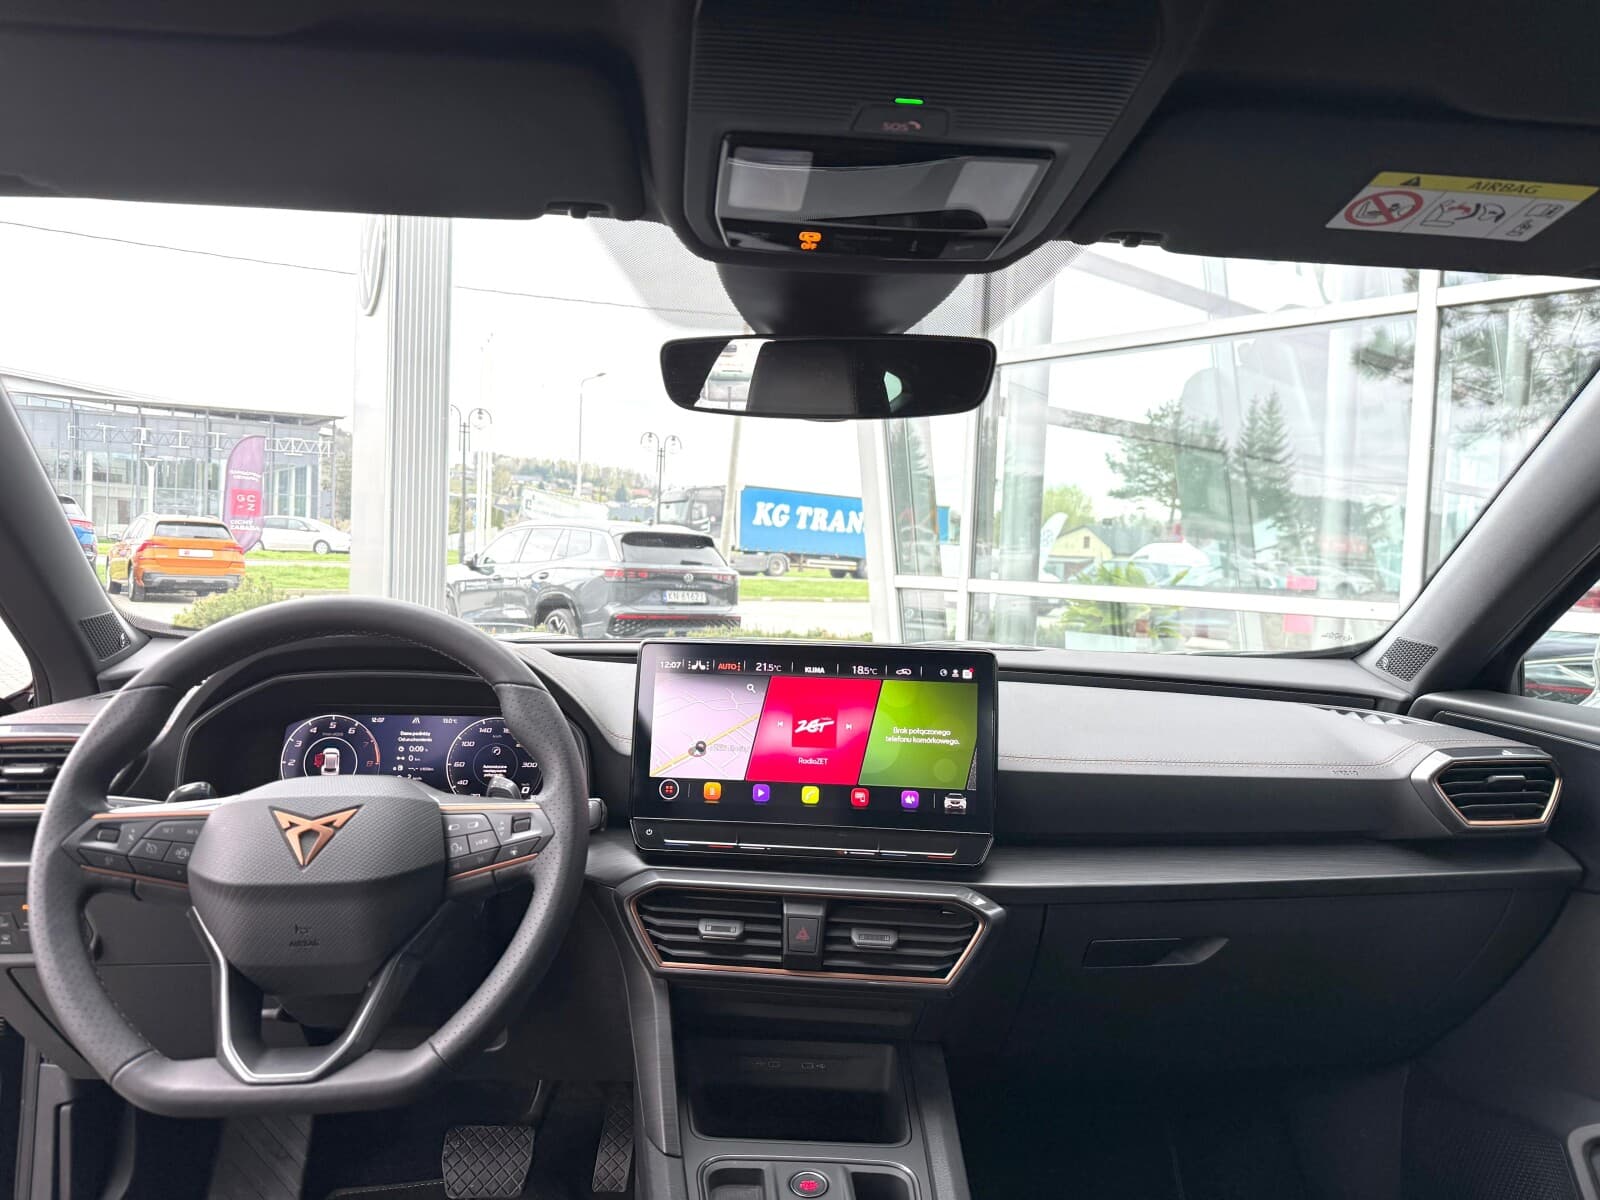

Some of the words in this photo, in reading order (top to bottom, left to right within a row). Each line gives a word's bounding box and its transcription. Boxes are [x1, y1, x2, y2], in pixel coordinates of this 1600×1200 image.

[1466, 180, 1543, 194] AIRBAG
[752, 501, 791, 528] KG
[660, 661, 682, 669] 12:07
[804, 666, 826, 674] KLIMA
[893, 726, 908, 734] Brak
[885, 735, 912, 743] telefonu
[295, 740, 302, 748] 3
[521, 786, 531, 794] 0
